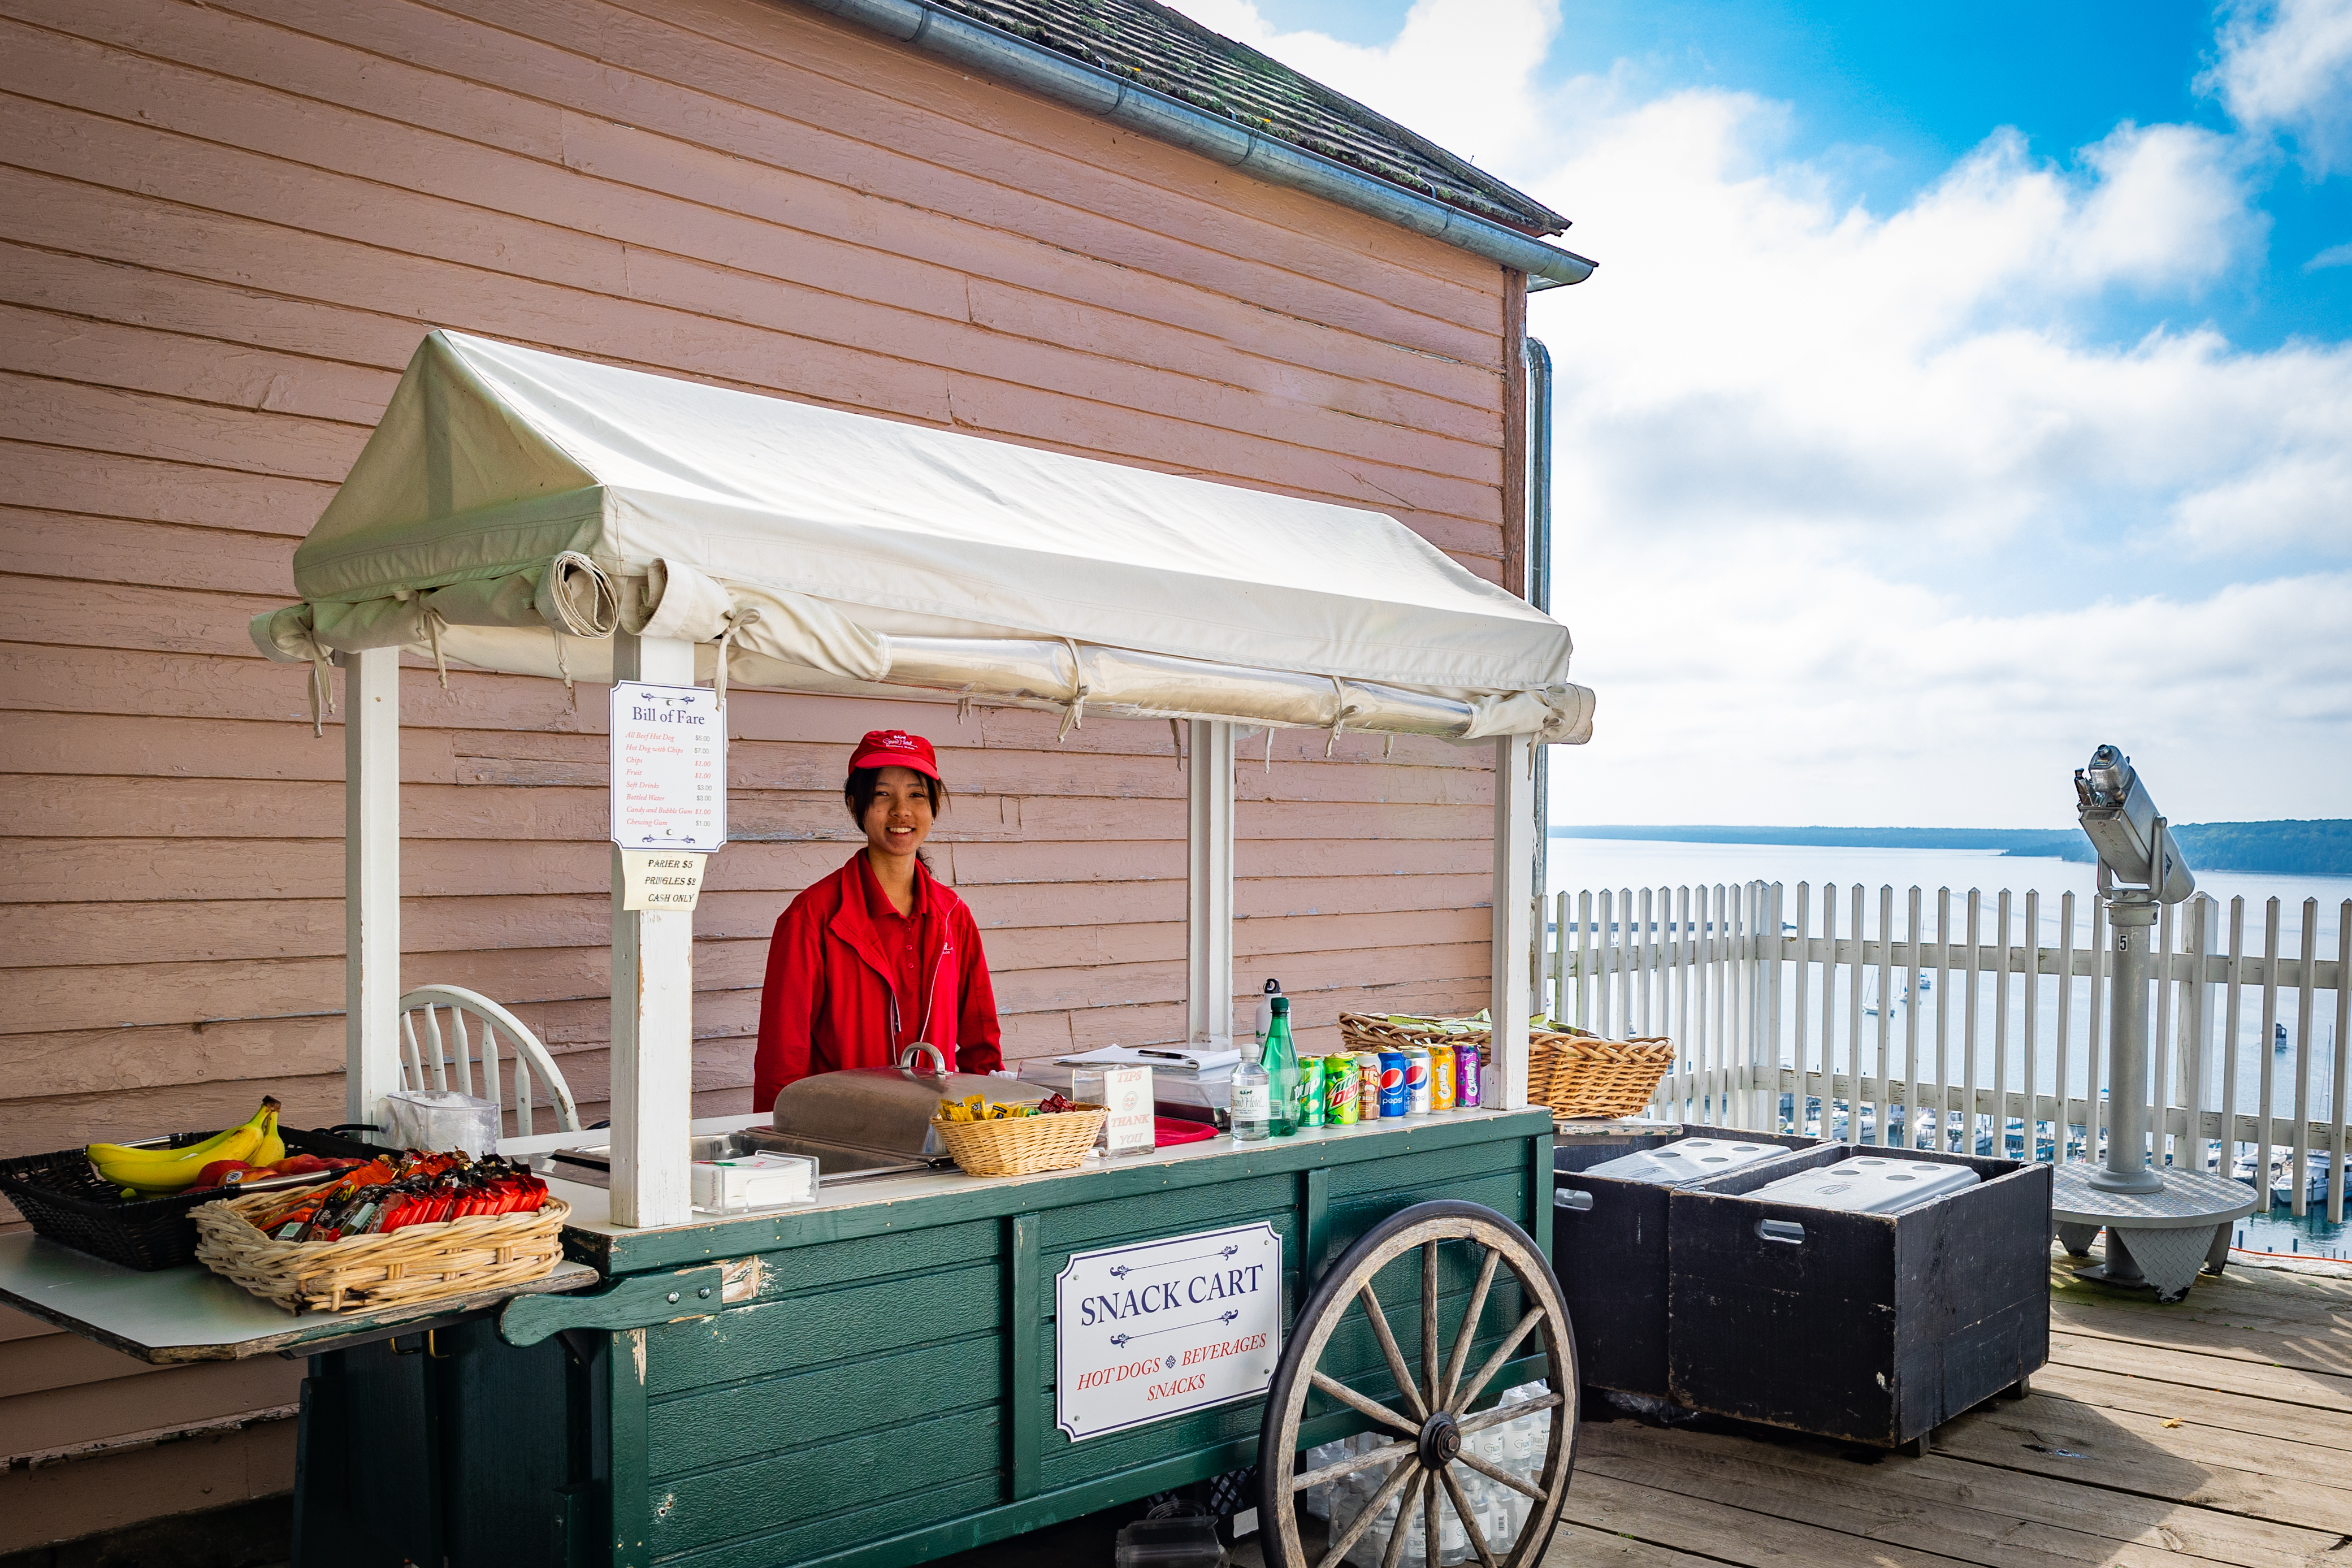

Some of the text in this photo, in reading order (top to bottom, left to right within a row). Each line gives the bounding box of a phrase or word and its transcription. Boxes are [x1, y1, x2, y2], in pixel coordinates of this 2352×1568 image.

[633, 707, 705, 725] Bill of Fare
[636, 732, 650, 741] Beef
[662, 734, 674, 743] Dog
[639, 744, 651, 753] Dog
[667, 747, 683, 755] Chips
[626, 756, 642, 765] Chips
[626, 781, 638, 790] Soft
[626, 806, 645, 815] Candy
[626, 818, 652, 828] Chewing
[648, 859, 694, 869] PARIER $5
[644, 876, 696, 886] PRINGLES $2
[648, 894, 695, 903] CASH ONLY
[2120, 935, 2126, 951] 5
[1117, 1070, 1142, 1083] TIPS
[1358, 1070, 1378, 1086] UG
[1383, 1097, 1402, 1105] pepsi
[1111, 1114, 1150, 1128] THANK
[1120, 1133, 1143, 1145] YOU
[1081, 1263, 1263, 1327] SNACK CART
[1181, 1333, 1266, 1366] BEVERAGES
[1147, 1373, 1206, 1401] SNACKS
